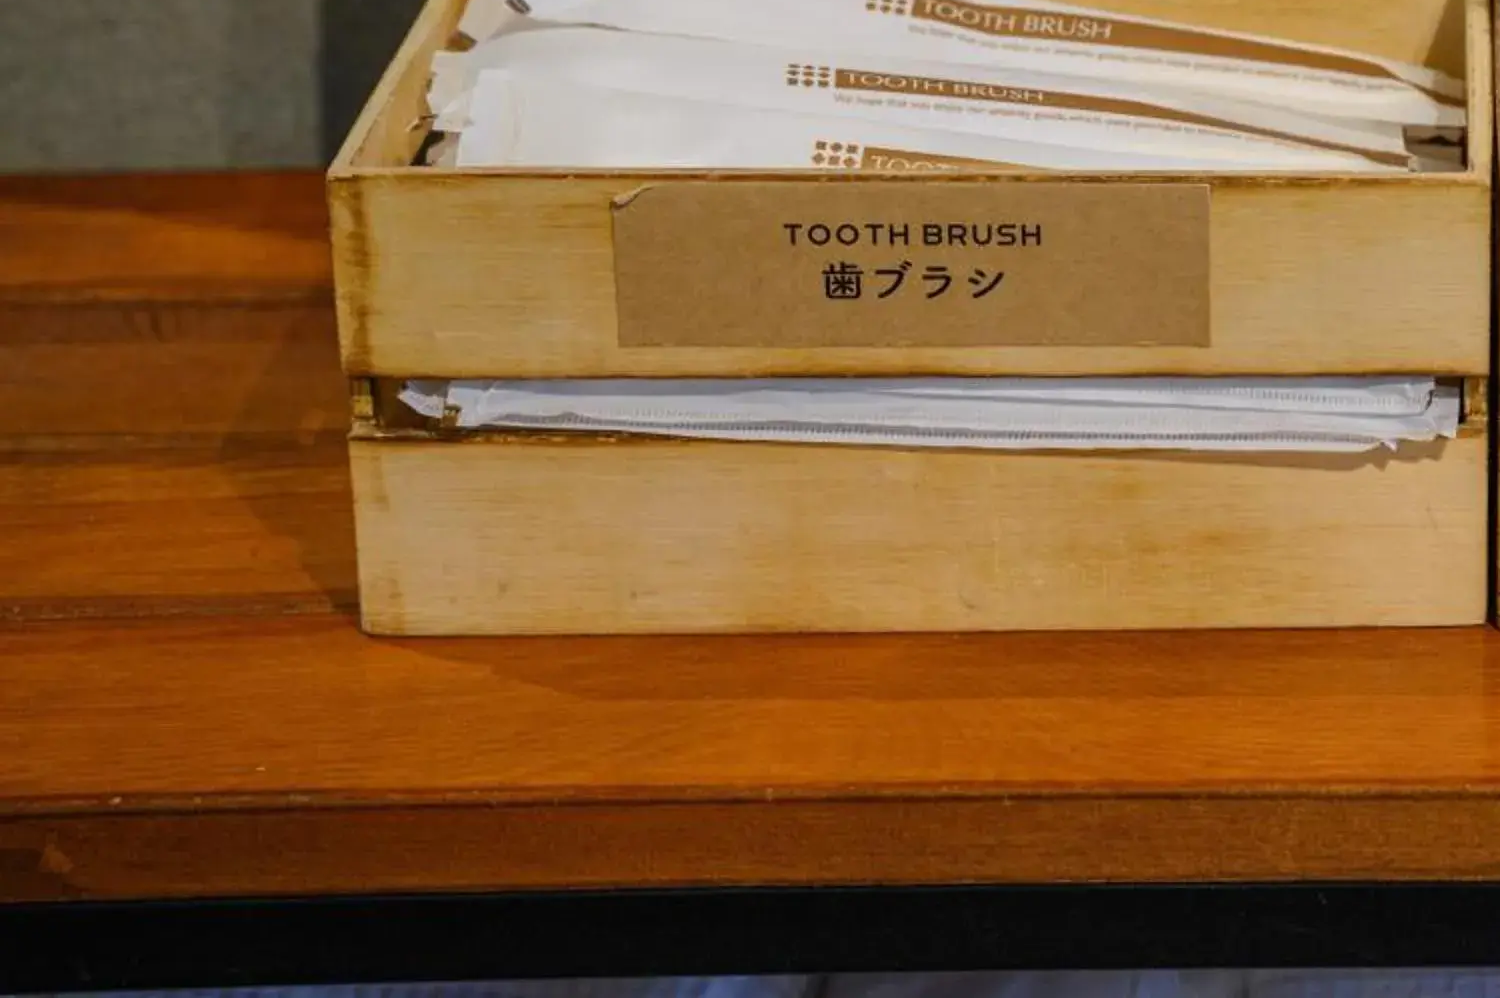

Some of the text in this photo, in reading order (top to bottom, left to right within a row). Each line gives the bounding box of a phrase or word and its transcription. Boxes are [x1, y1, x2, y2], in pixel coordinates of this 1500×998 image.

[1023, 13, 1113, 39] BRUSH
[843, 72, 1045, 103] TOOTH BRUSH
[783, 223, 1042, 247] TOOTH BRUSH
[822, 260, 1004, 300] 歯ブラシ
